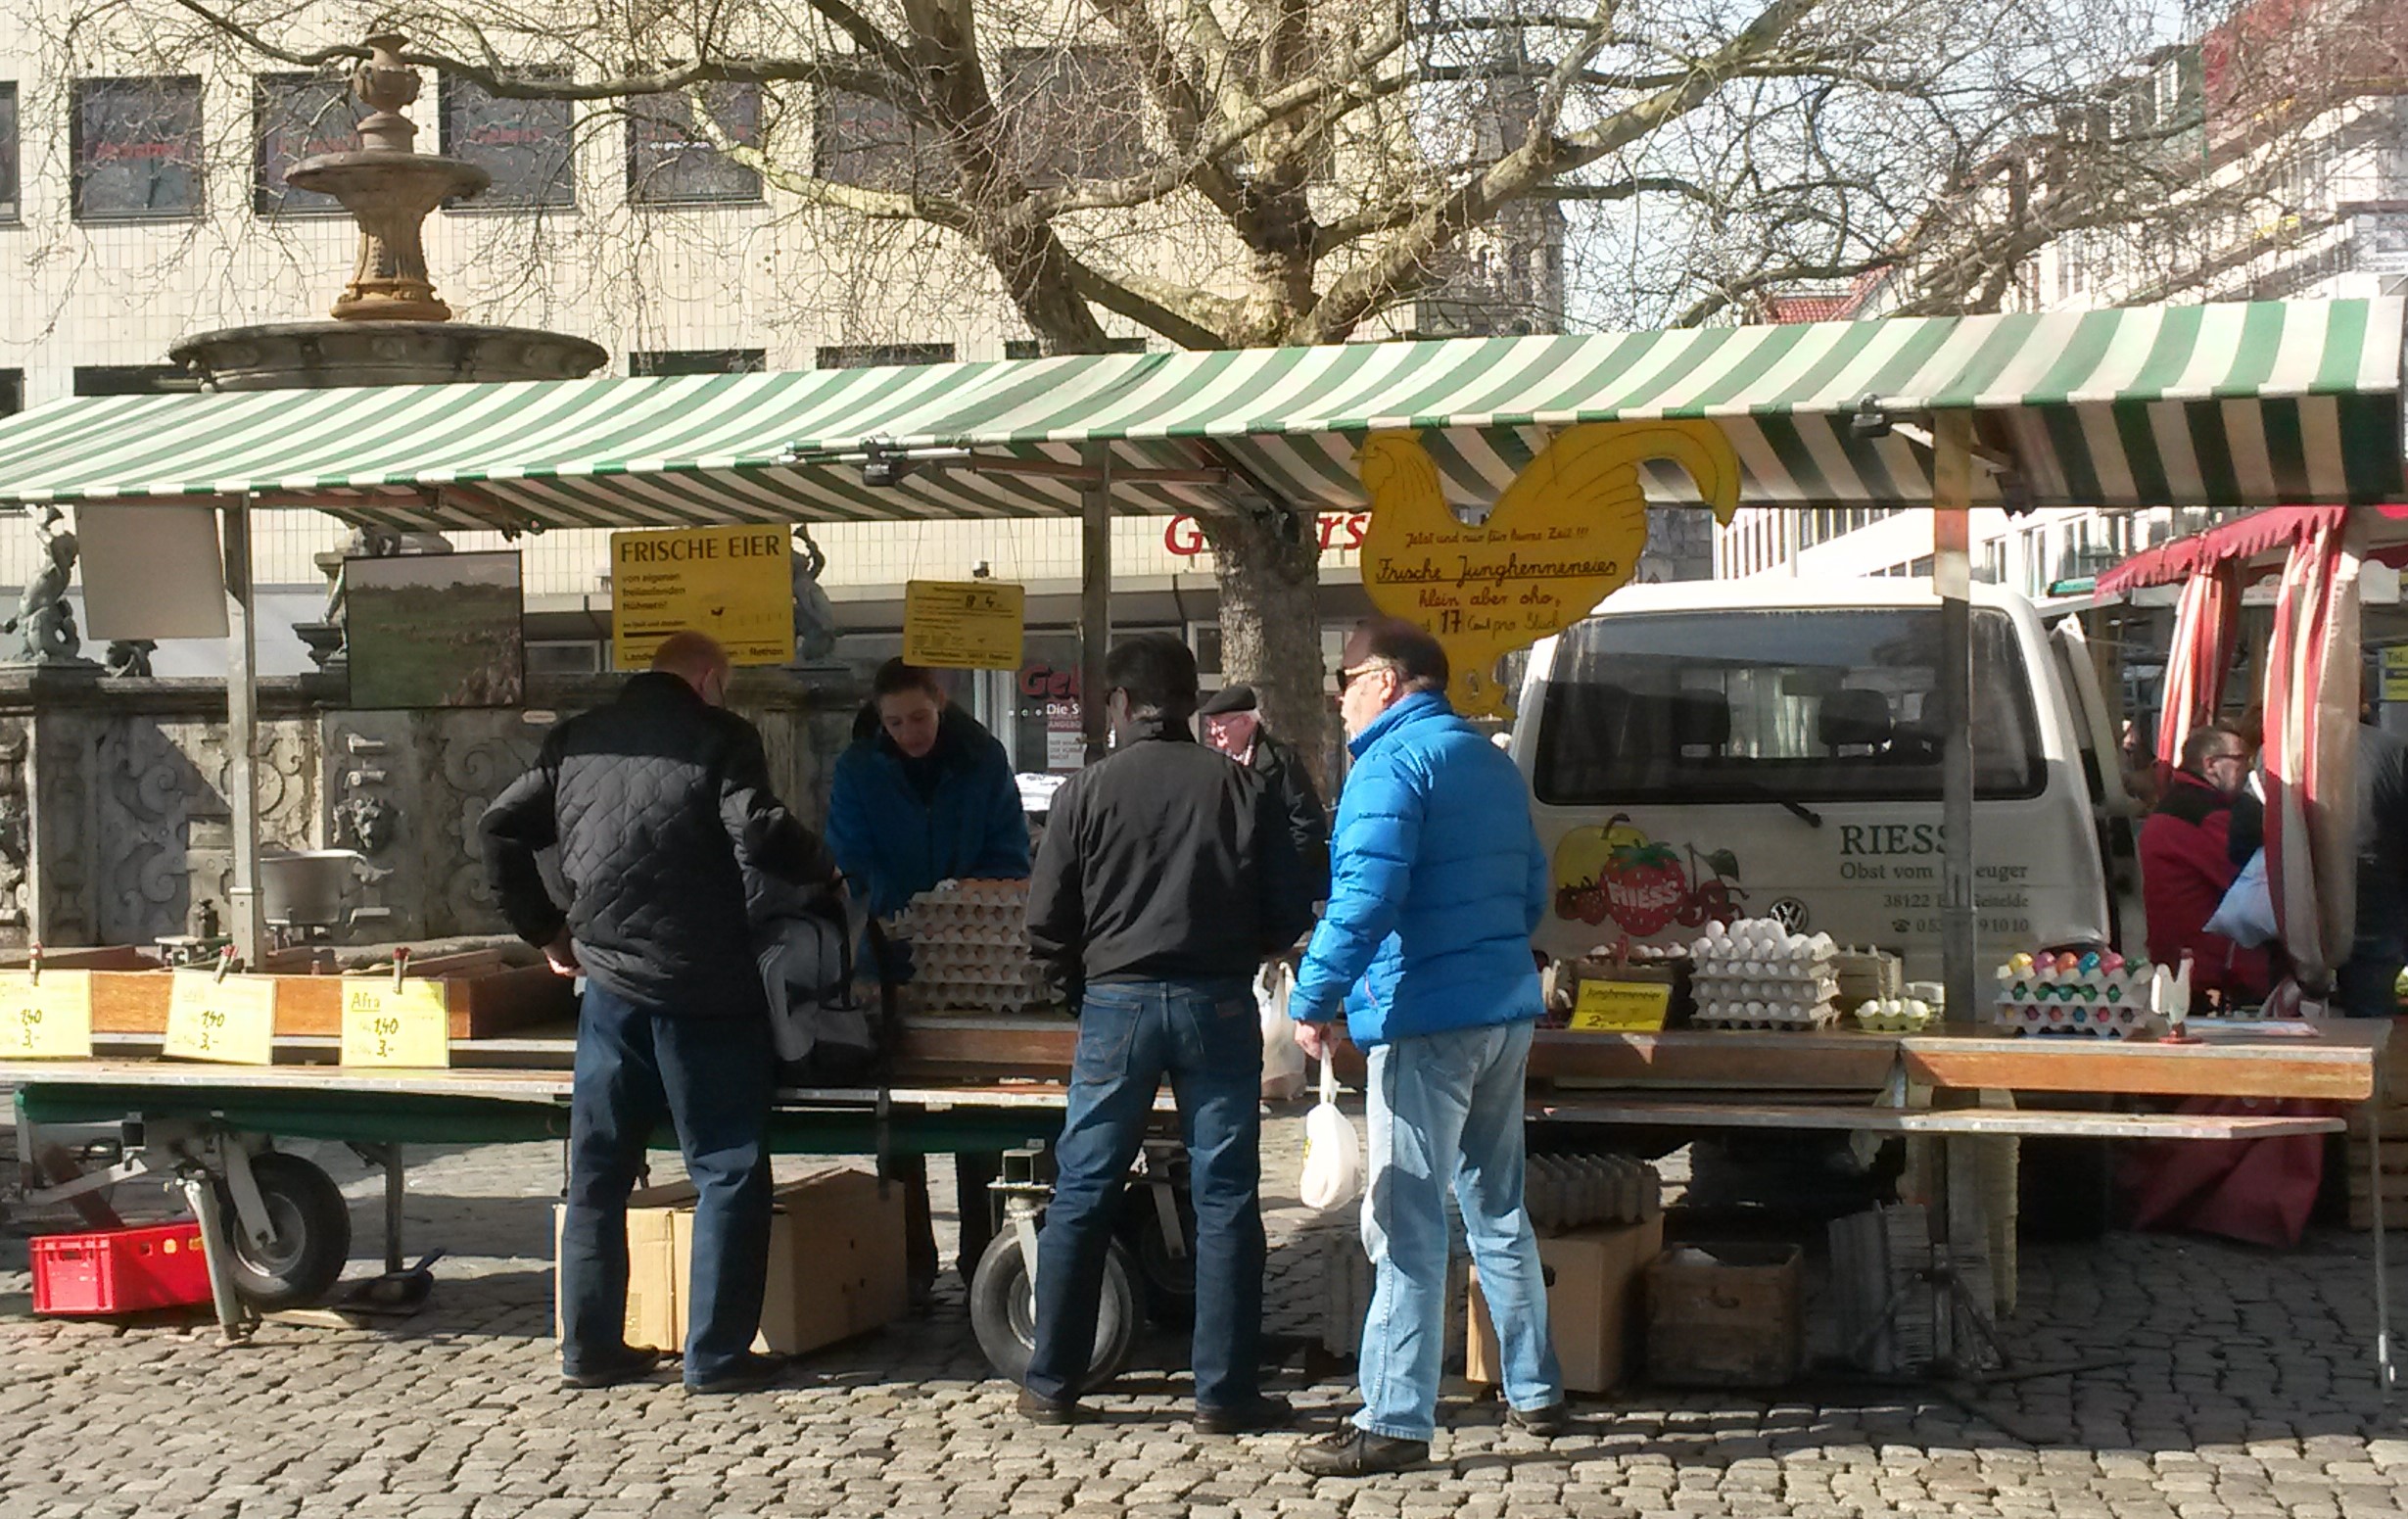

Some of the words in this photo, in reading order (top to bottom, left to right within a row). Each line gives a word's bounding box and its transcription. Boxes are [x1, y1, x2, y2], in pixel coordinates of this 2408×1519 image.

[1437, 532, 1459, 545] und
[1461, 534, 1485, 544] nur
[621, 538, 719, 562] FRISCHE
[729, 535, 780, 557] EIER
[1377, 557, 1441, 581] Frische
[1419, 589, 1460, 608] klein
[1470, 586, 1508, 605] aber
[1440, 609, 1462, 634] 17
[1493, 620, 1516, 639] pro
[1047, 703, 1068, 715] Die
[1840, 862, 1885, 879] Obst
[1893, 867, 1933, 878] vom
[1884, 893, 1930, 908] 38122
[374, 1018, 399, 1036] 1,40
